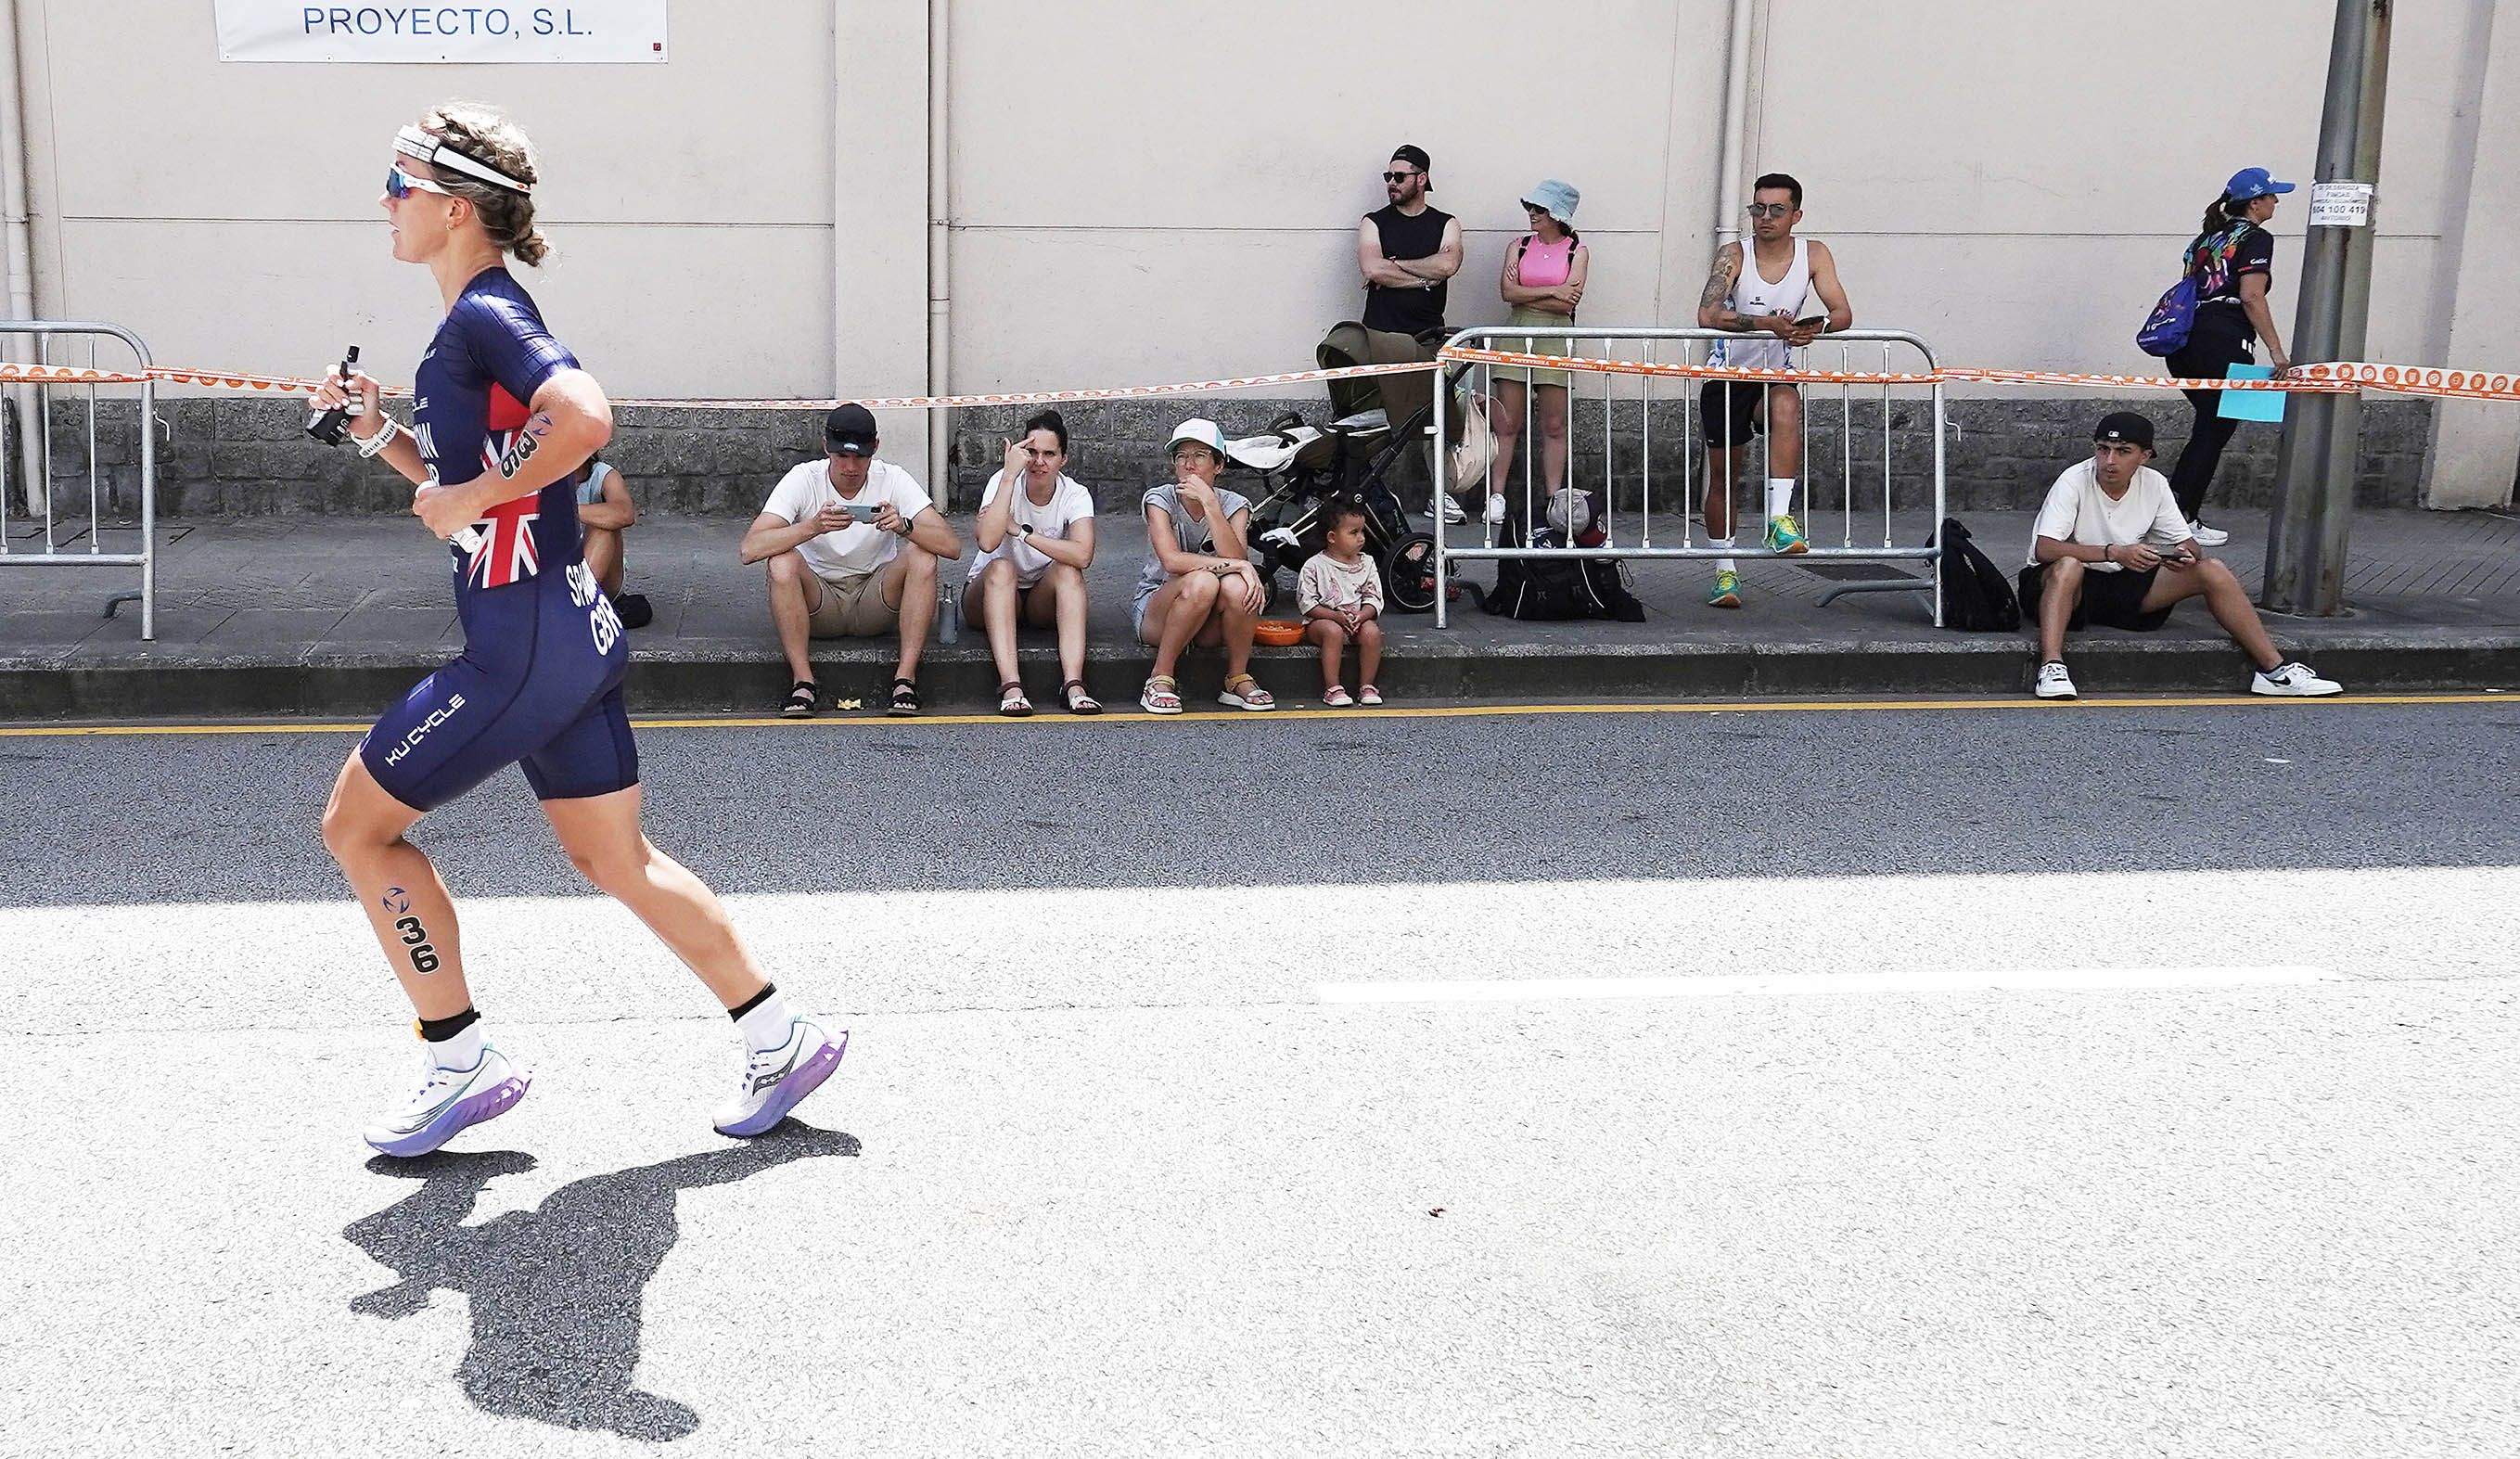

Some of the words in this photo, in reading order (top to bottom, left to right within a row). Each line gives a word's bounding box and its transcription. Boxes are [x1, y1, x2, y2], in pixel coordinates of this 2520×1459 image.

[303, 8, 520, 40] PROYECTO,
[532, 8, 594, 35] S.L.
[2329, 205, 2346, 213] 100
[499, 430, 540, 480] 36
[590, 594, 624, 656] GBR
[385, 740, 411, 767] KU
[406, 693, 466, 746] CYCLE
[395, 915, 441, 974] 36
